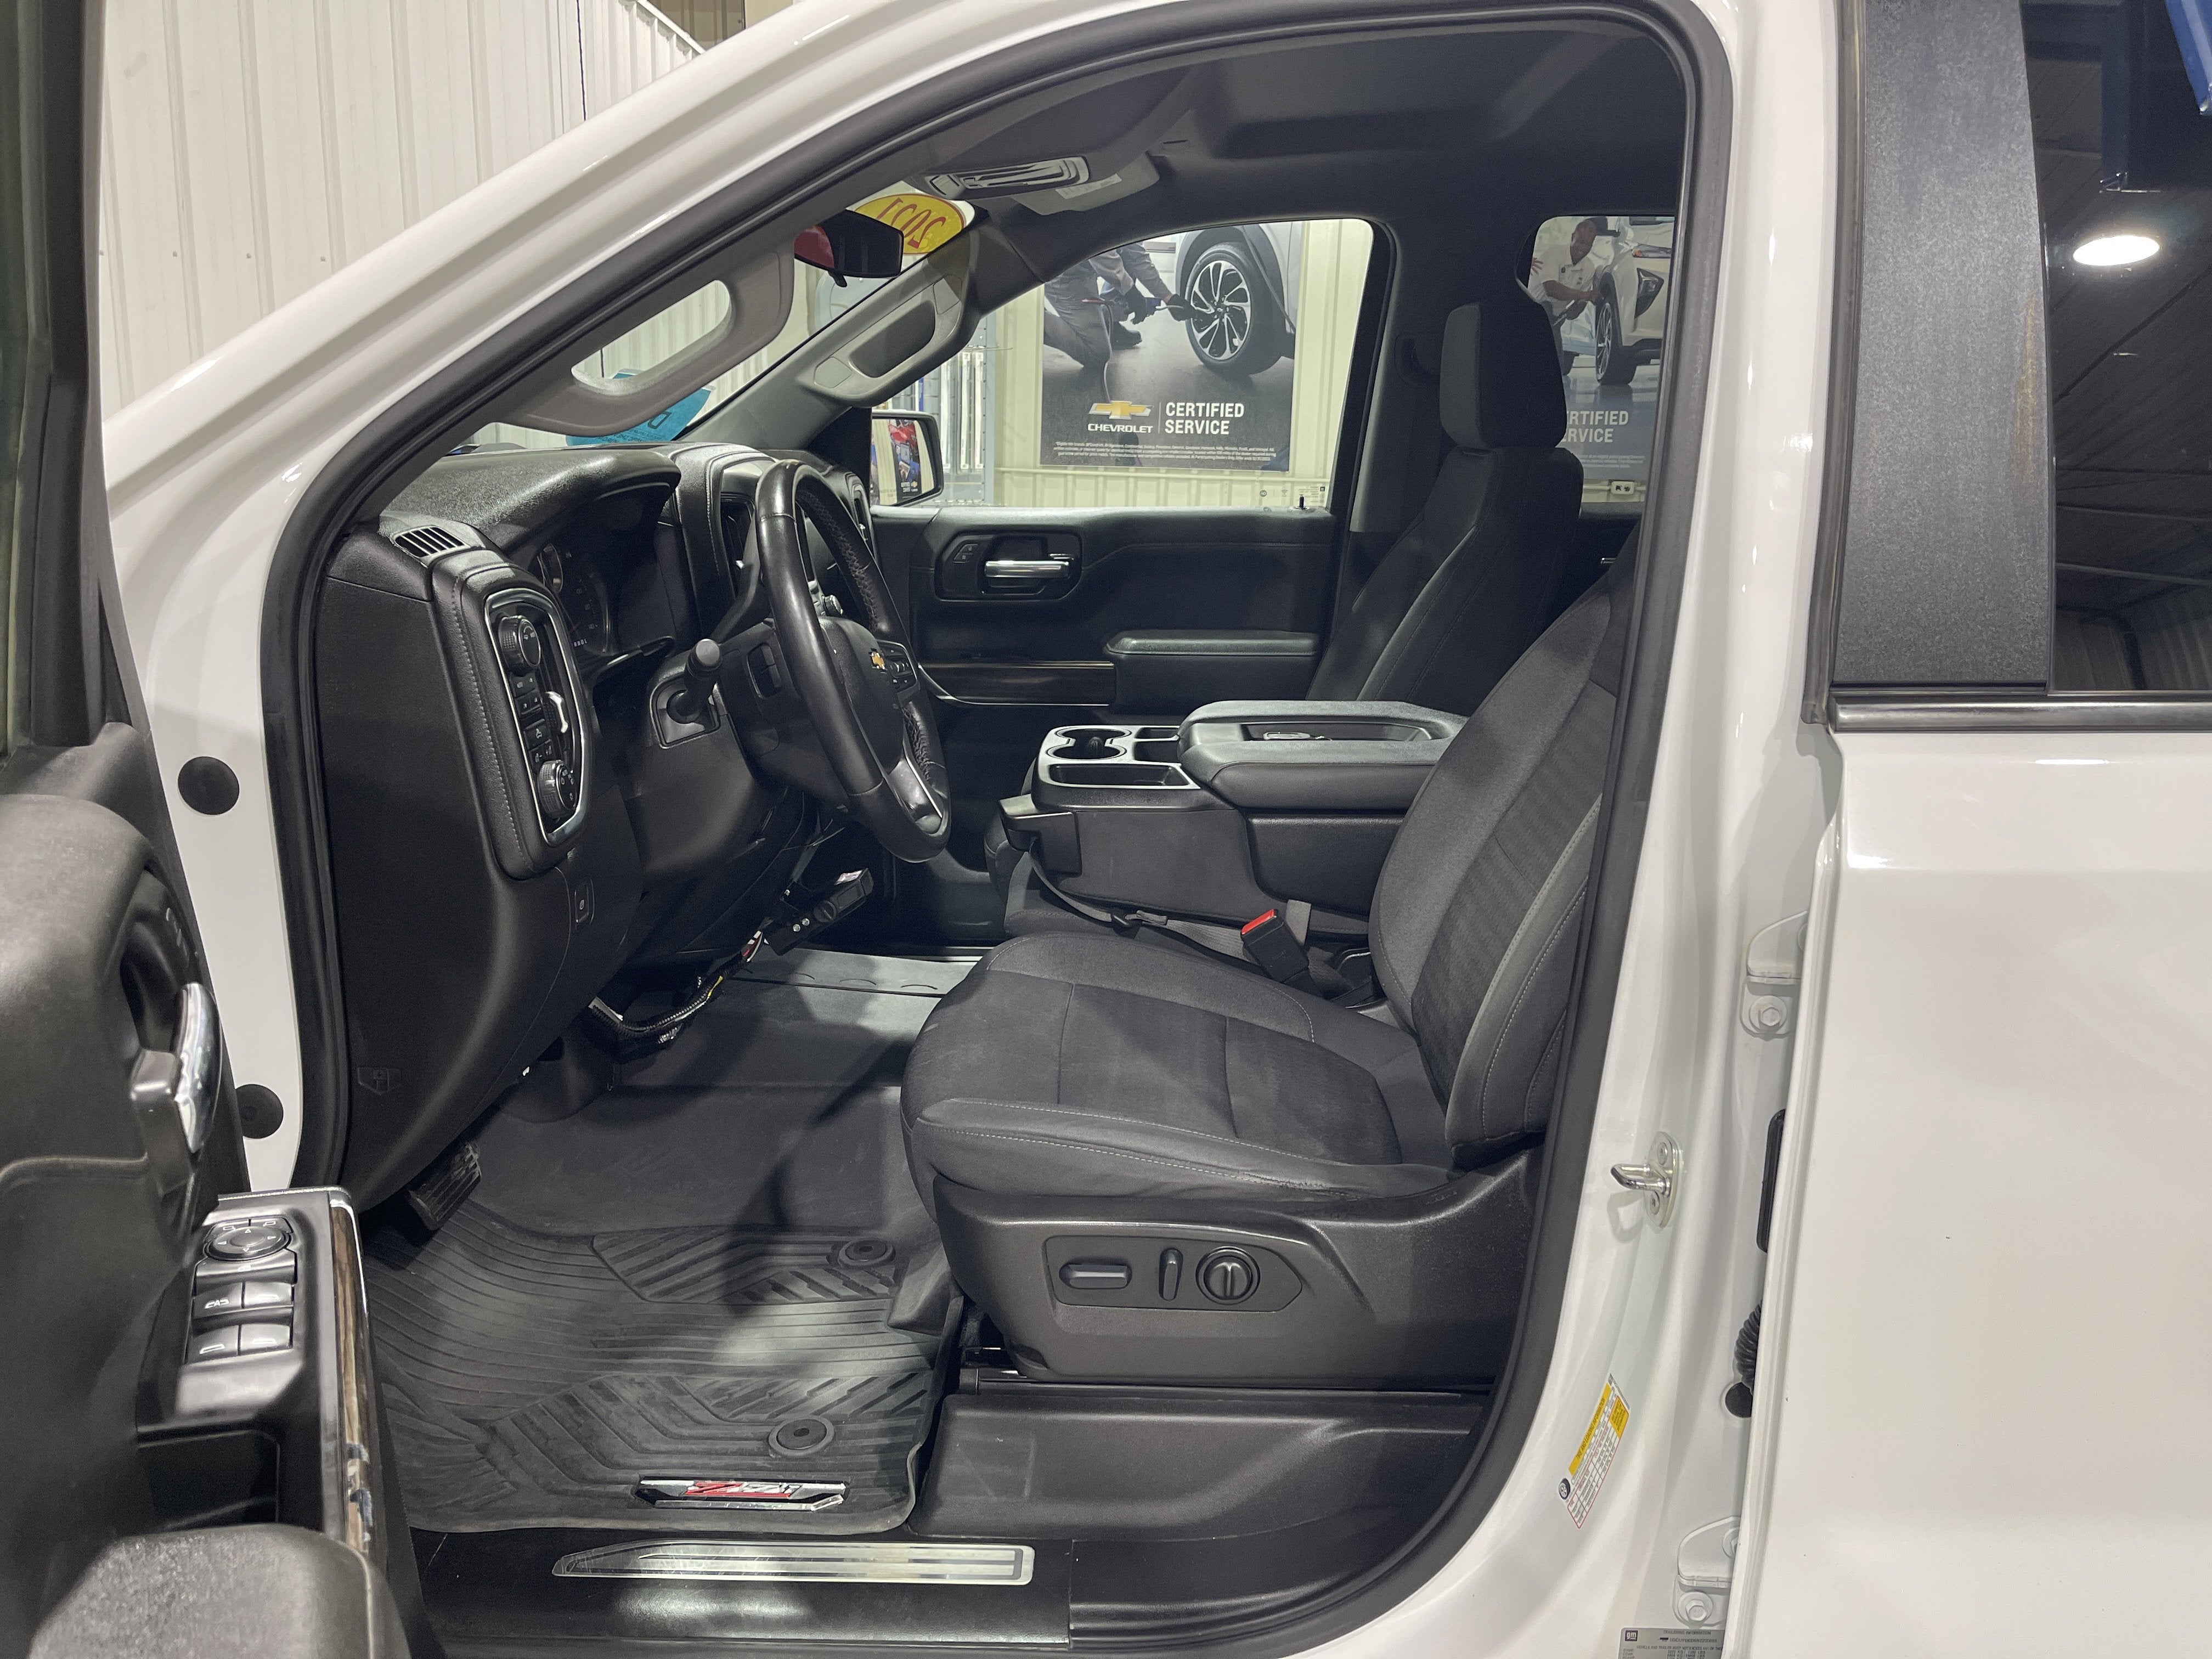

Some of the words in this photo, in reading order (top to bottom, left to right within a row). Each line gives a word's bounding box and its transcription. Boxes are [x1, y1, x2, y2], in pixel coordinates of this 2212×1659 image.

[1165, 402, 1245, 417] CERTIFIED
[1567, 410, 1629, 425] RTIFIED
[1087, 423, 1154, 433] CHEVROLET
[1164, 419, 1230, 435] SERVICE
[1561, 428, 1614, 443] RVICE
